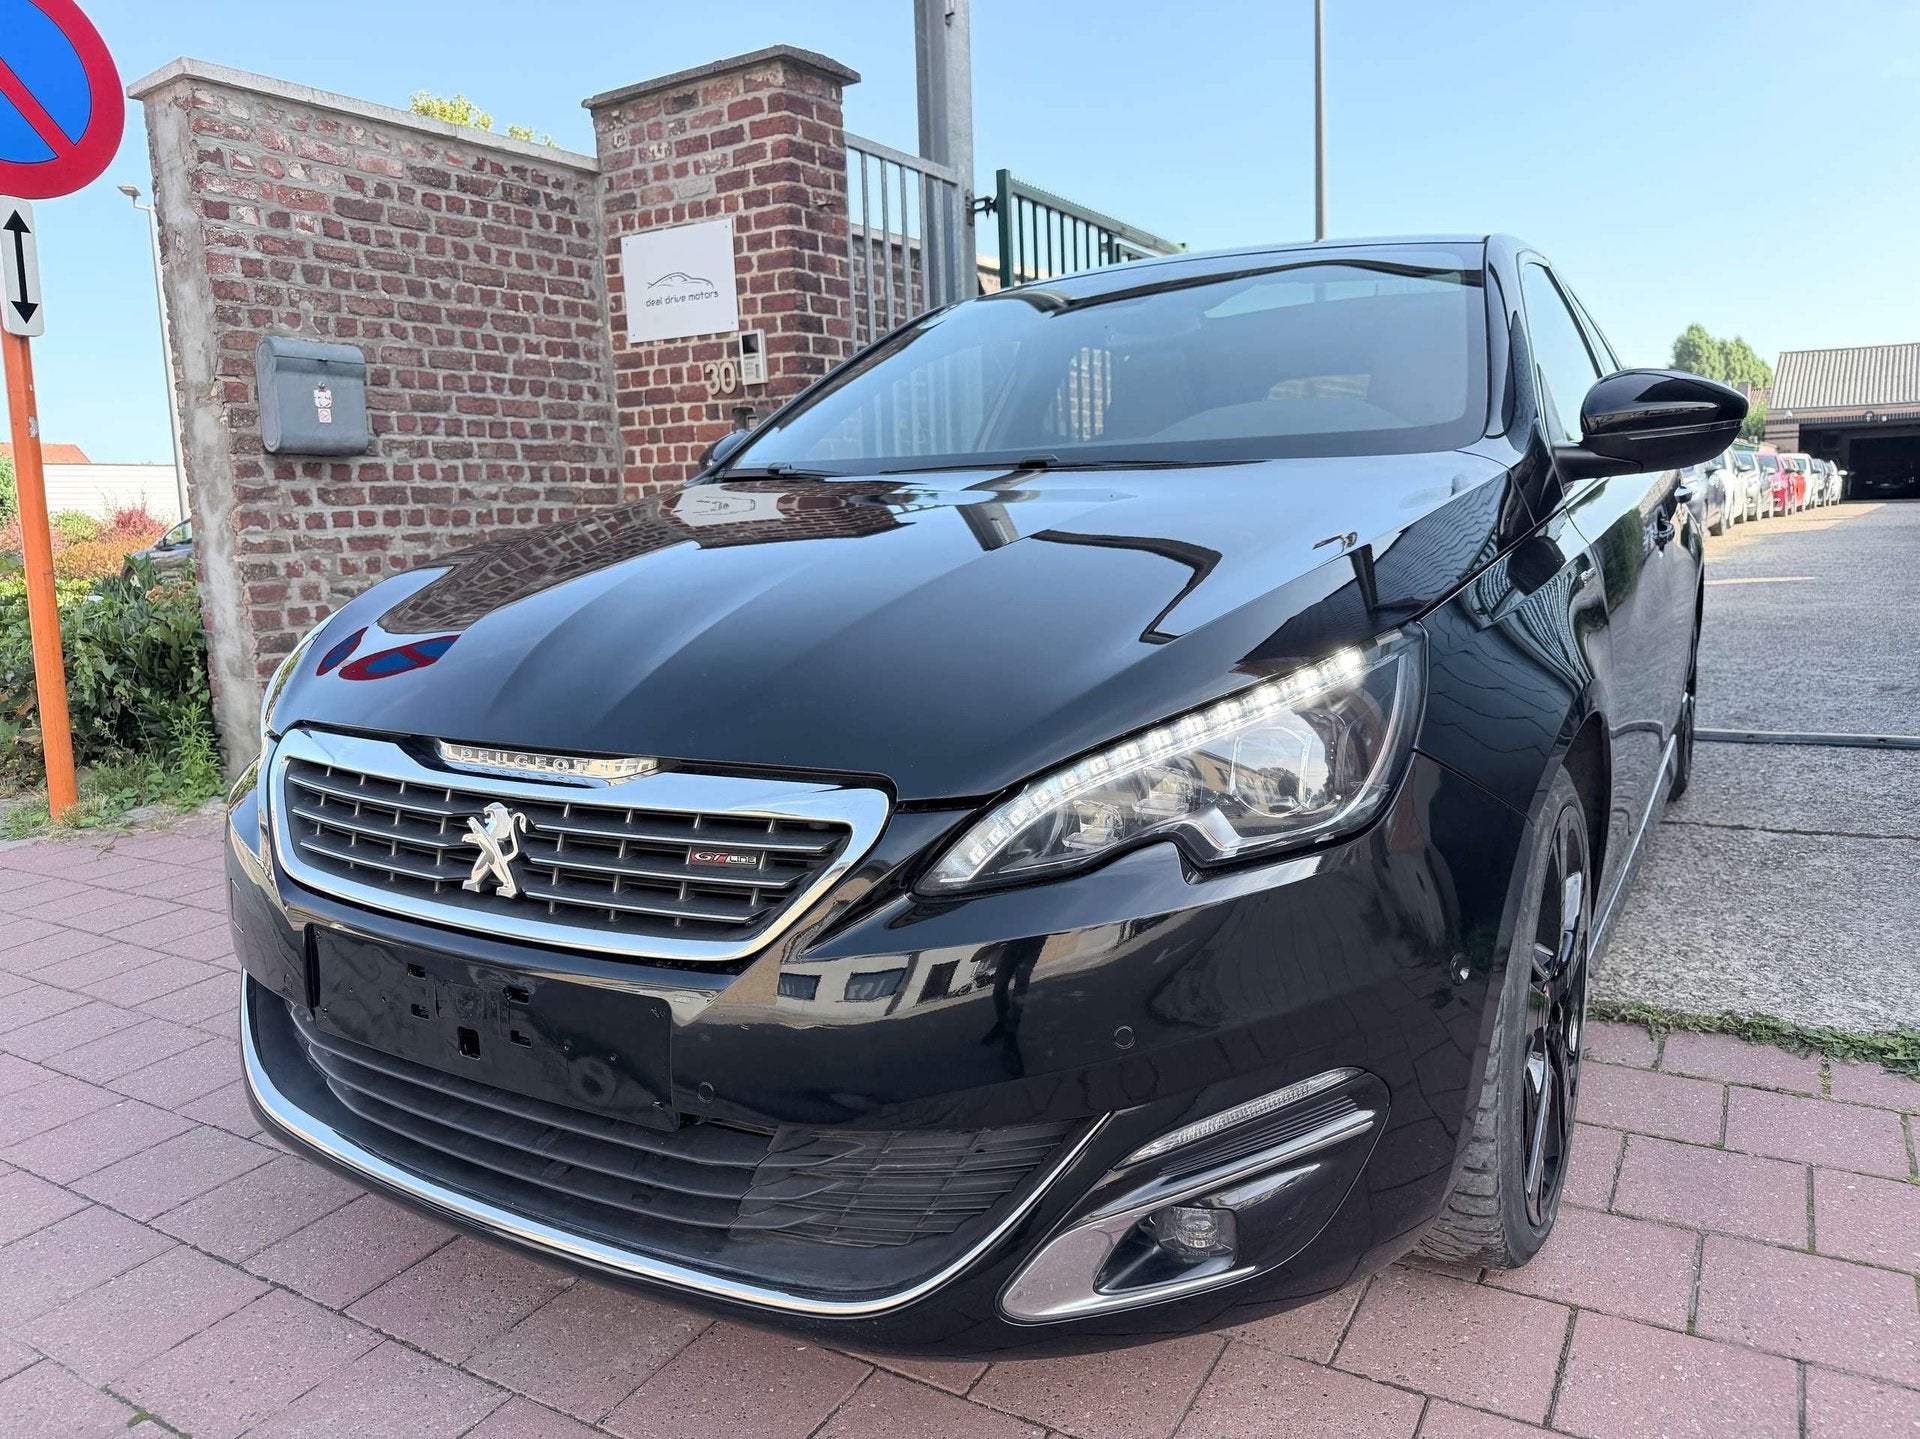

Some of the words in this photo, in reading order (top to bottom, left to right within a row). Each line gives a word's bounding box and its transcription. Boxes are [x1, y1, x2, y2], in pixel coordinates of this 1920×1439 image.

[645, 296, 663, 307] deal
[665, 295, 686, 304] drive
[688, 290, 719, 300] motors
[704, 361, 736, 395] 30
[460, 748, 591, 773] PEUGEOT
